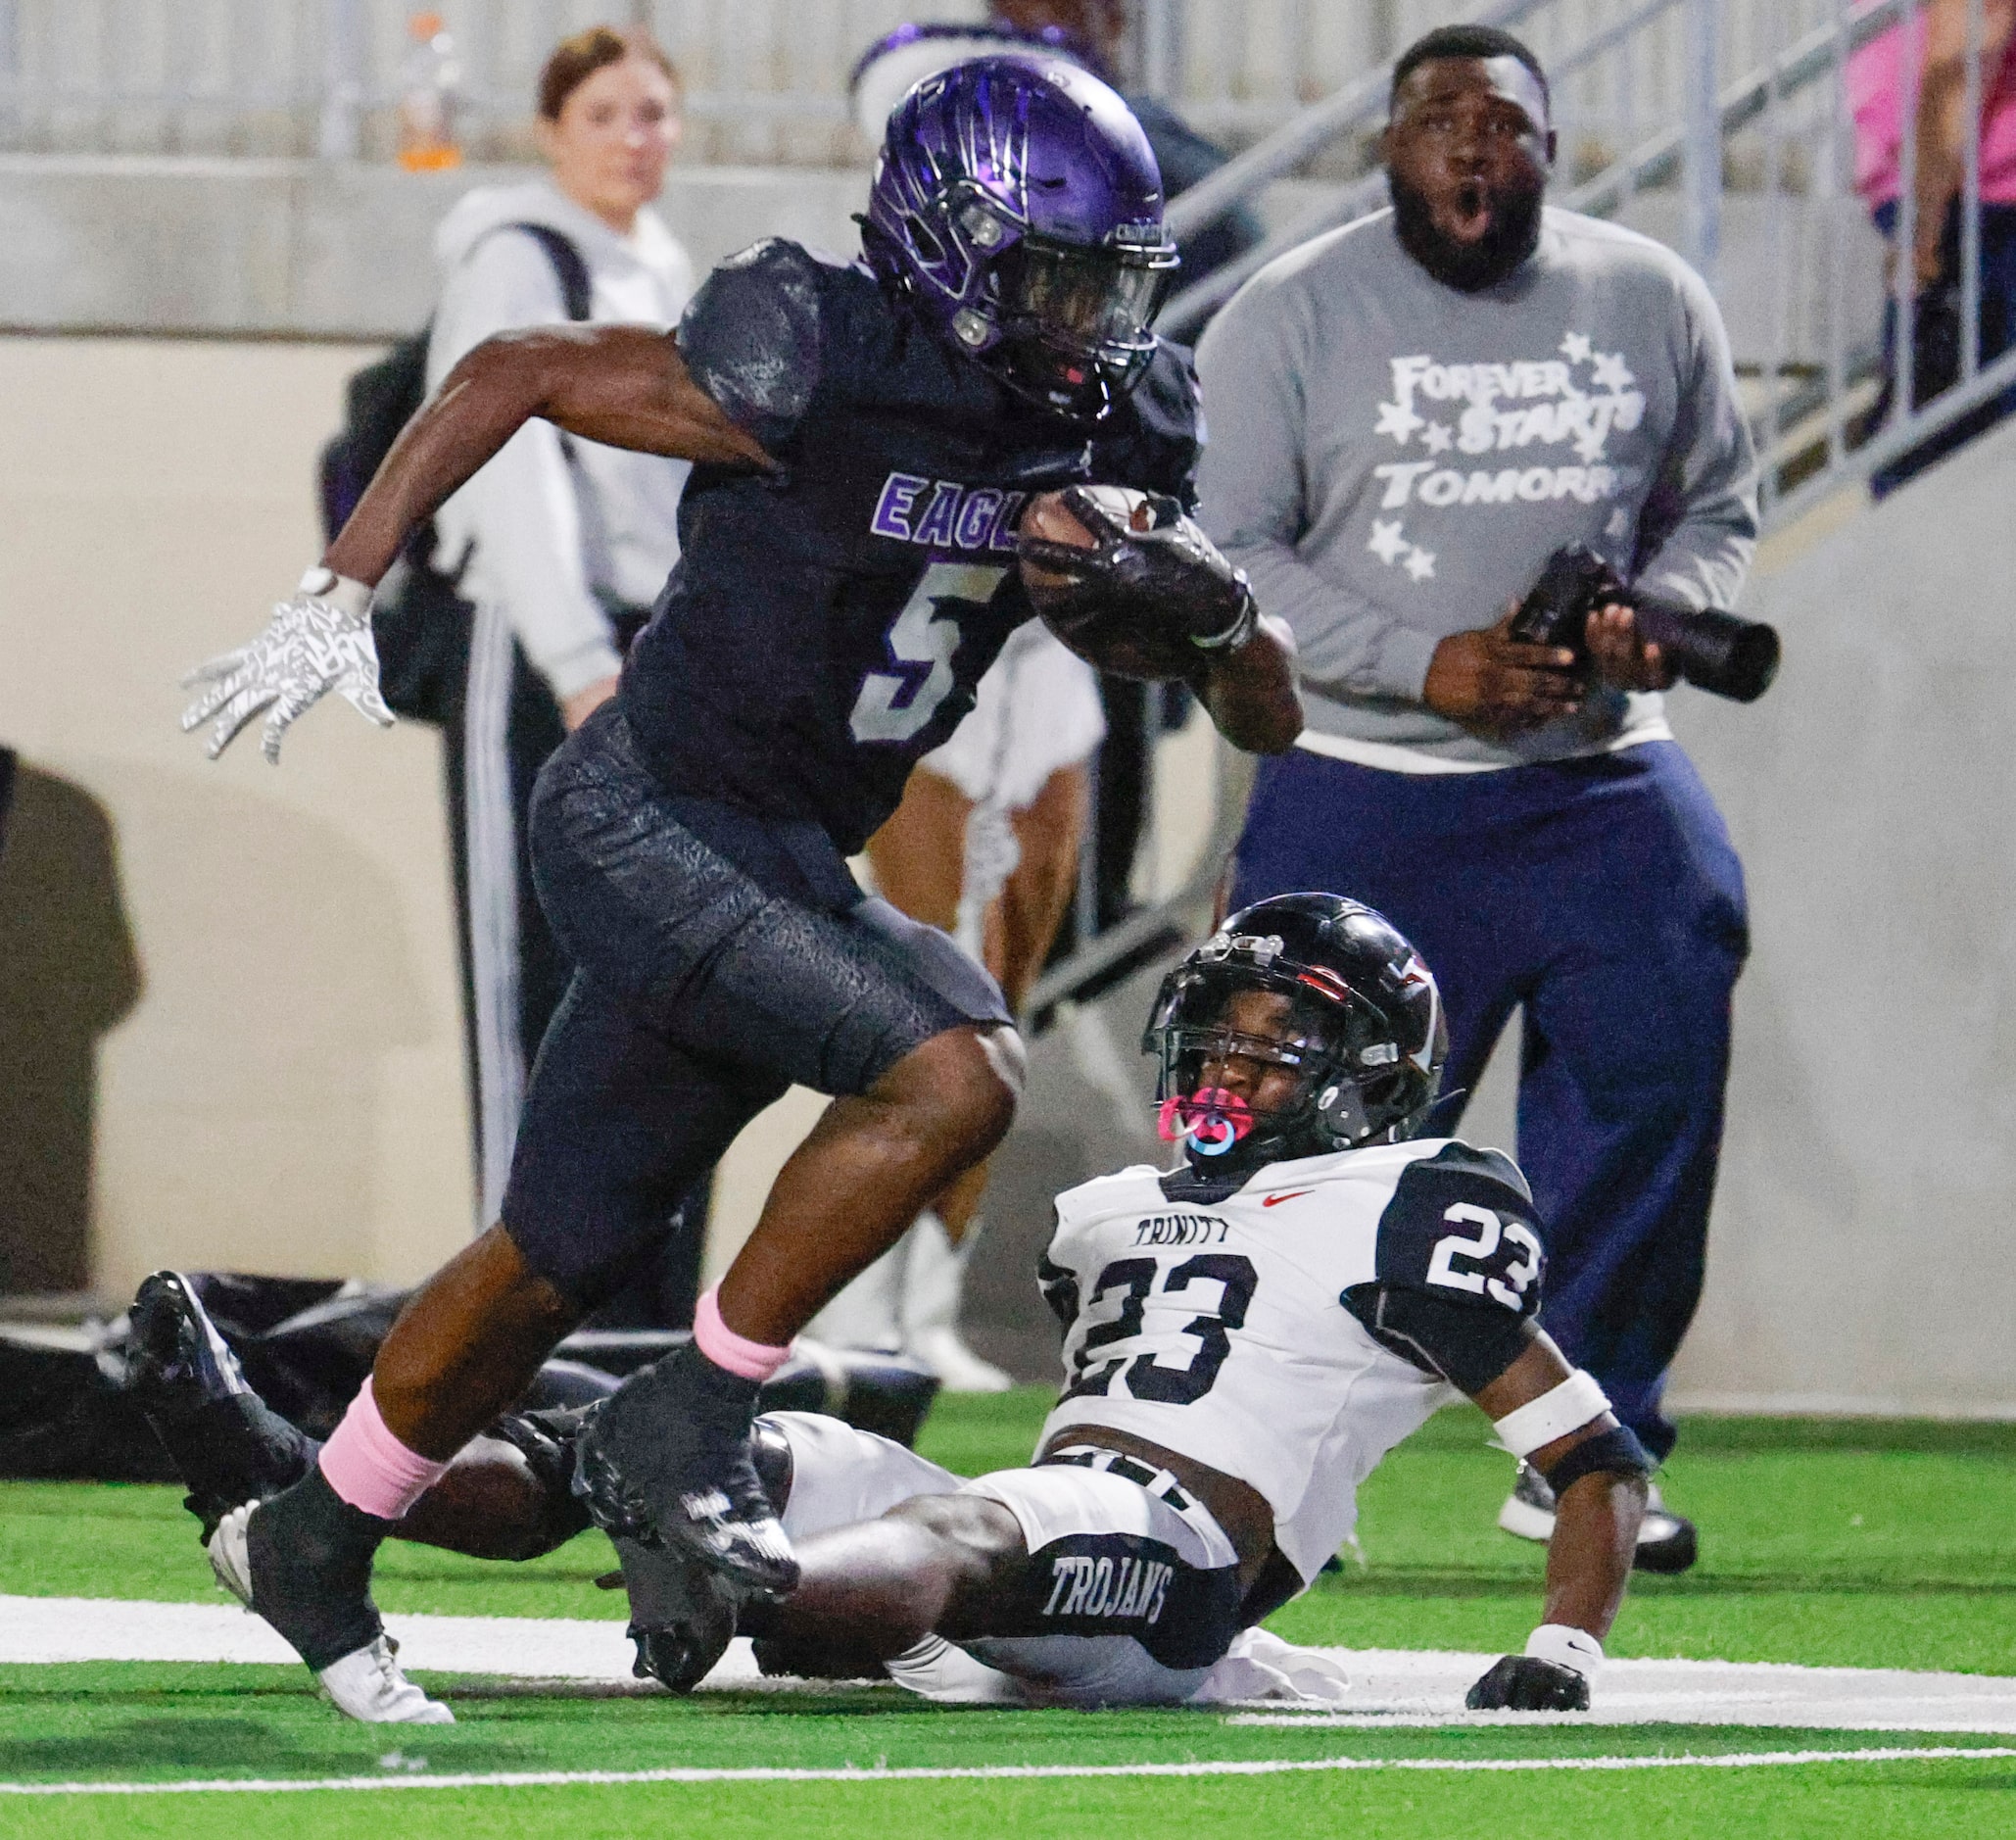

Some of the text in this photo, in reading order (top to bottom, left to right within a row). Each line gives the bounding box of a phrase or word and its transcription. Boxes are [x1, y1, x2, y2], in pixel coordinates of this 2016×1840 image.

[1389, 354, 1573, 408] FOREVER
[847, 559, 1010, 745] 5
[1129, 1214, 1229, 1247] TRINITY
[1426, 1201, 1542, 1312] 23
[1058, 1253, 1259, 1405] 23
[1042, 1556, 1175, 1624] TROJANS
